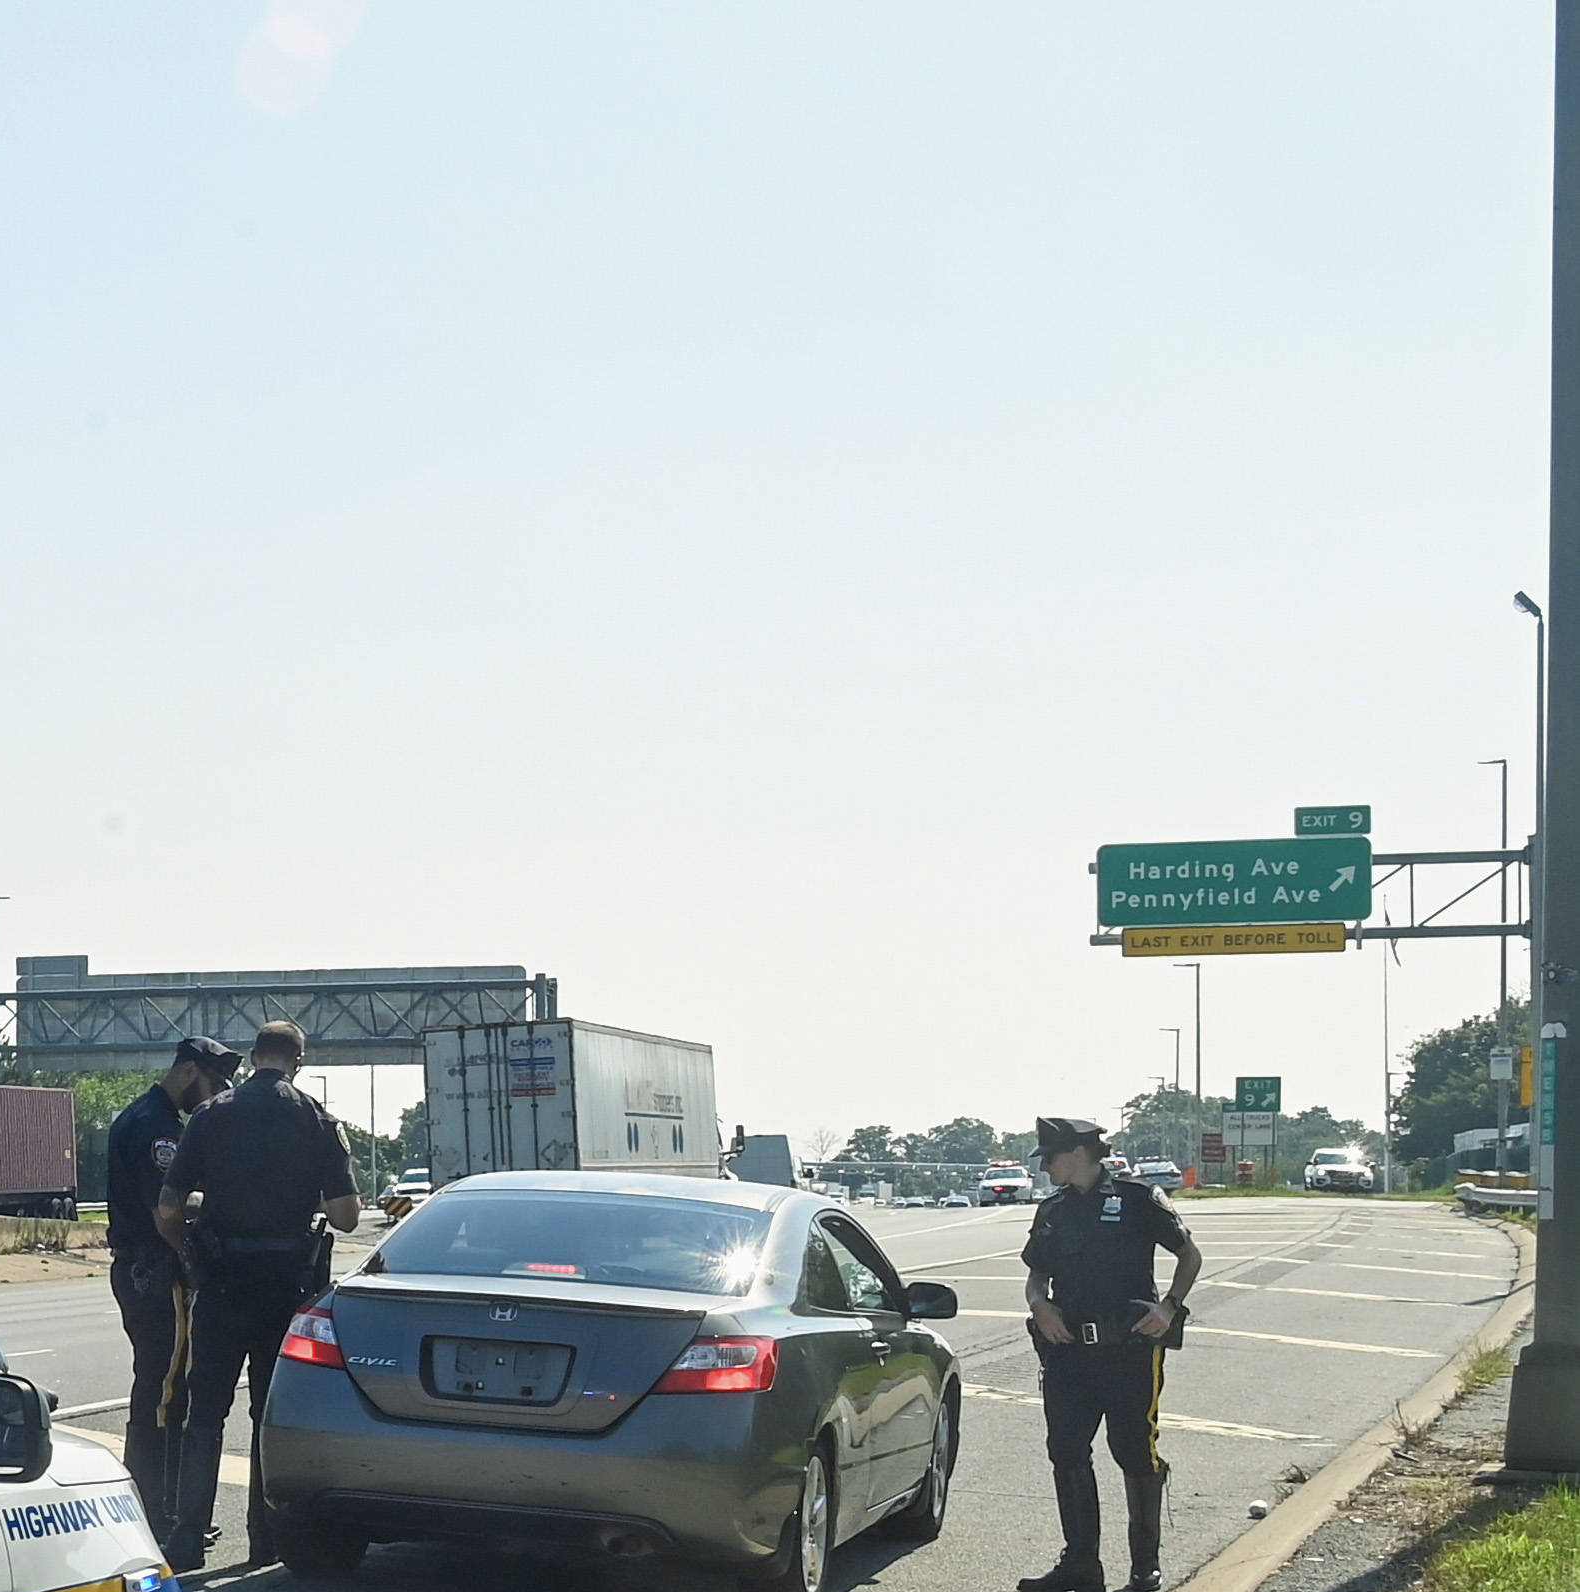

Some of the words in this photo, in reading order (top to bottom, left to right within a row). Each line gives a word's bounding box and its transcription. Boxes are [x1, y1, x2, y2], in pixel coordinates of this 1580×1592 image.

[1302, 815, 1337, 828] EXIT
[1348, 811, 1364, 829] 9
[1129, 859, 1235, 882] Harding
[1251, 858, 1300, 877] Ave
[1111, 886, 1257, 911] Pennyfield
[1272, 885, 1321, 904] Ave
[1131, 936, 1171, 949] LAST
[1180, 934, 1214, 947] EXIT
[1224, 932, 1287, 946] BEFORE
[1297, 931, 1336, 944] TOLL
[1244, 1080, 1272, 1089] EXIT
[1244, 1093, 1255, 1107] 9
[347, 1356, 398, 1366] CIVIC
[1, 1498, 105, 1541] HIGHWAY
[100, 1494, 142, 1524] UNIT
